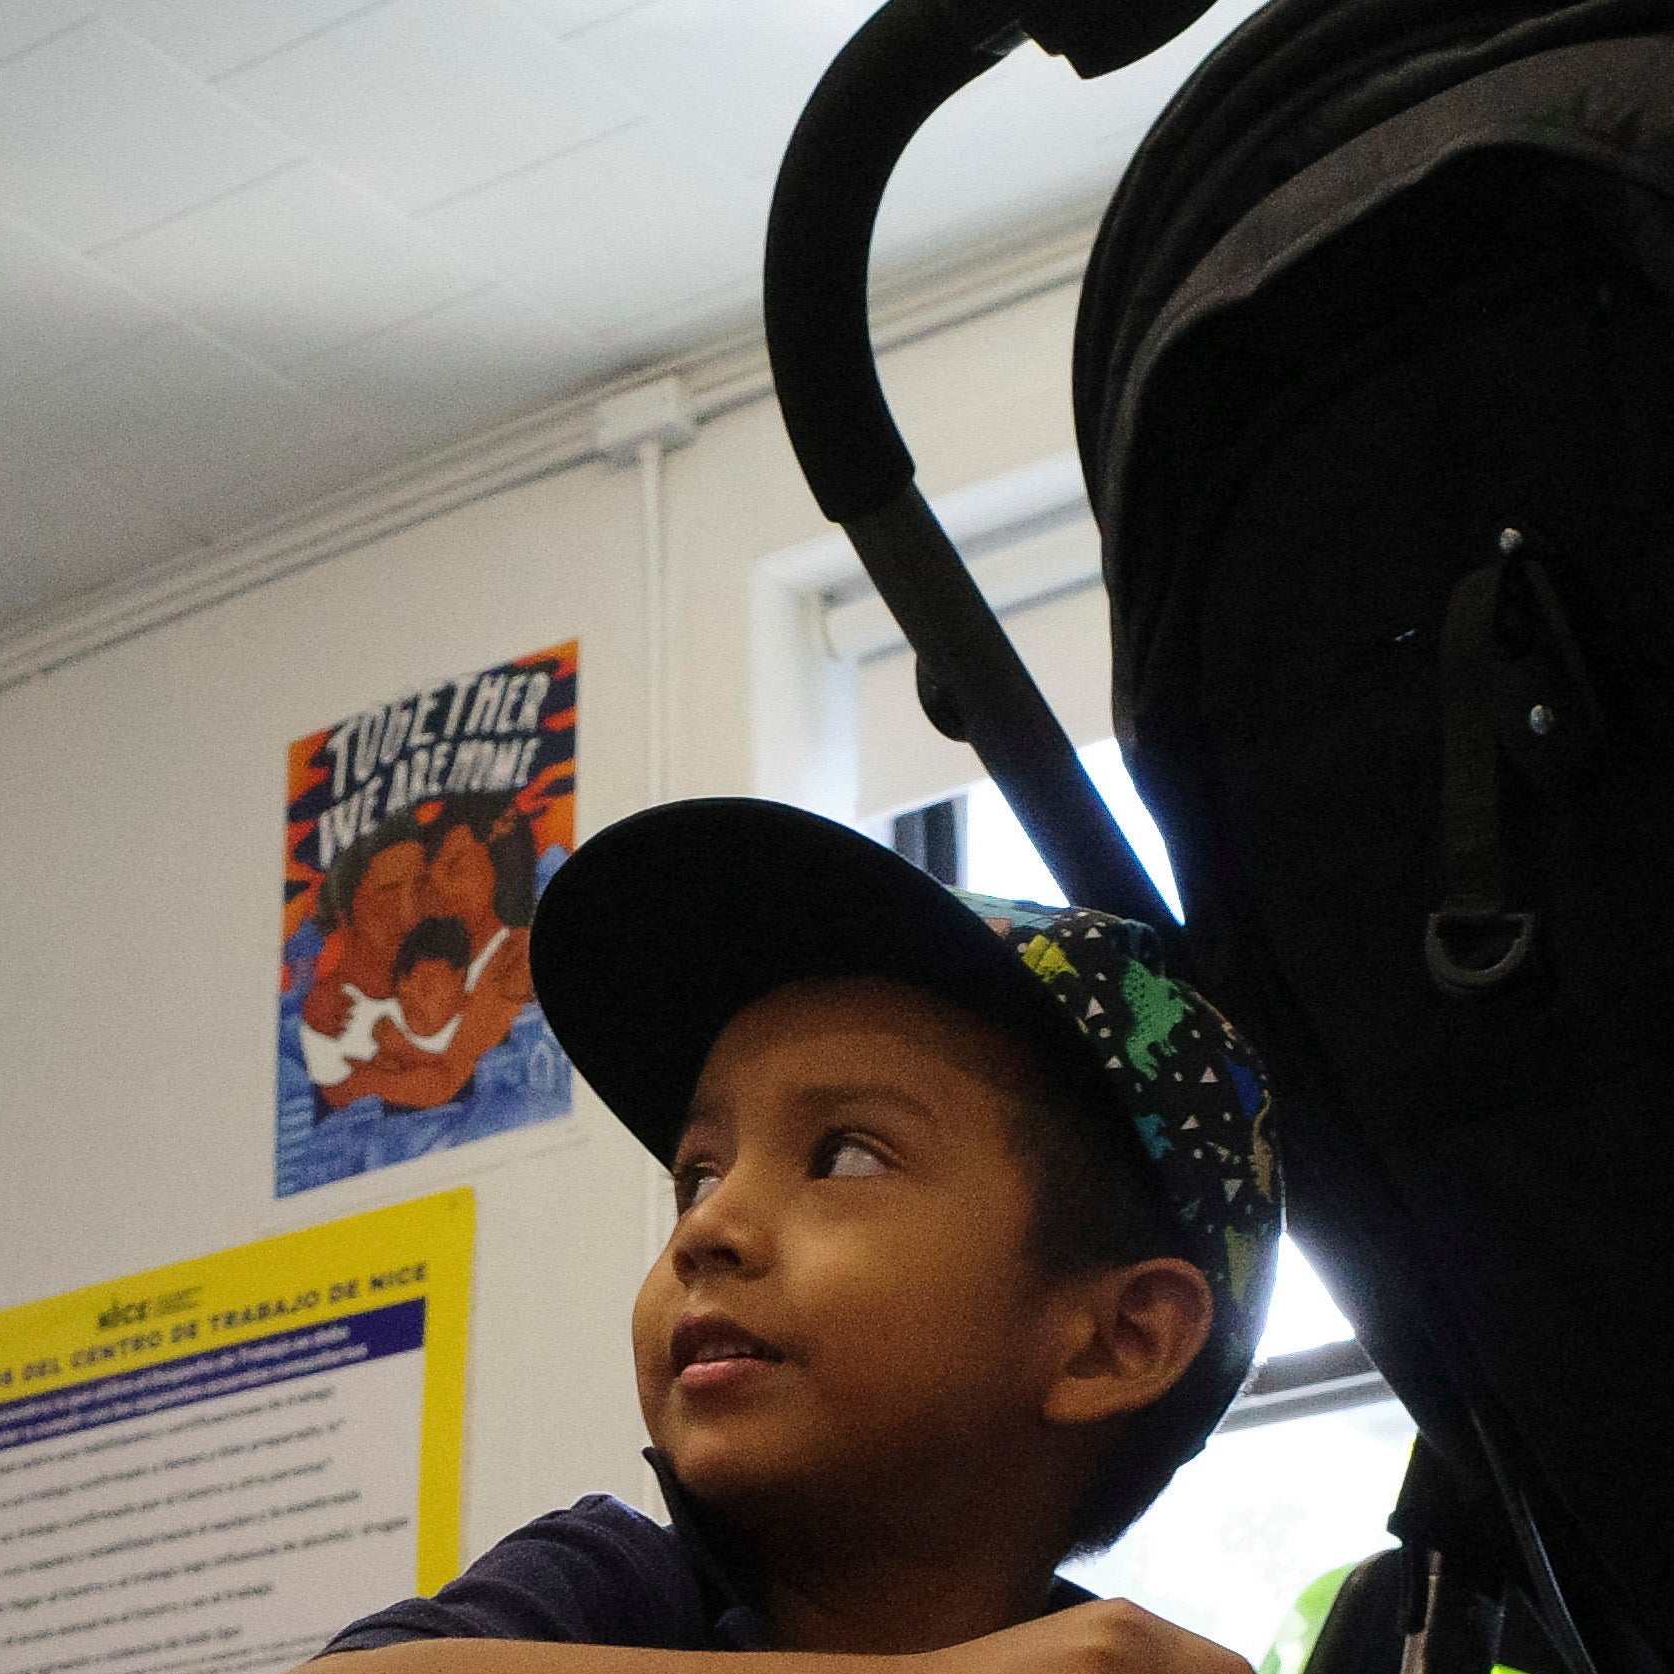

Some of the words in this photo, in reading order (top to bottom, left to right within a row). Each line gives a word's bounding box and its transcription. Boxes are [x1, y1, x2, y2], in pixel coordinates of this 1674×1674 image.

[327, 671, 551, 799] TOGETHER
[319, 776, 383, 869] WE
[385, 741, 452, 813] ARE
[21, 1357, 62, 1383] DEL
[70, 1329, 164, 1370] CENTRO
[170, 1318, 200, 1344] DE
[209, 1288, 322, 1332] TRABAJO
[328, 1278, 360, 1305] DE
[369, 1261, 427, 1291] NICE
